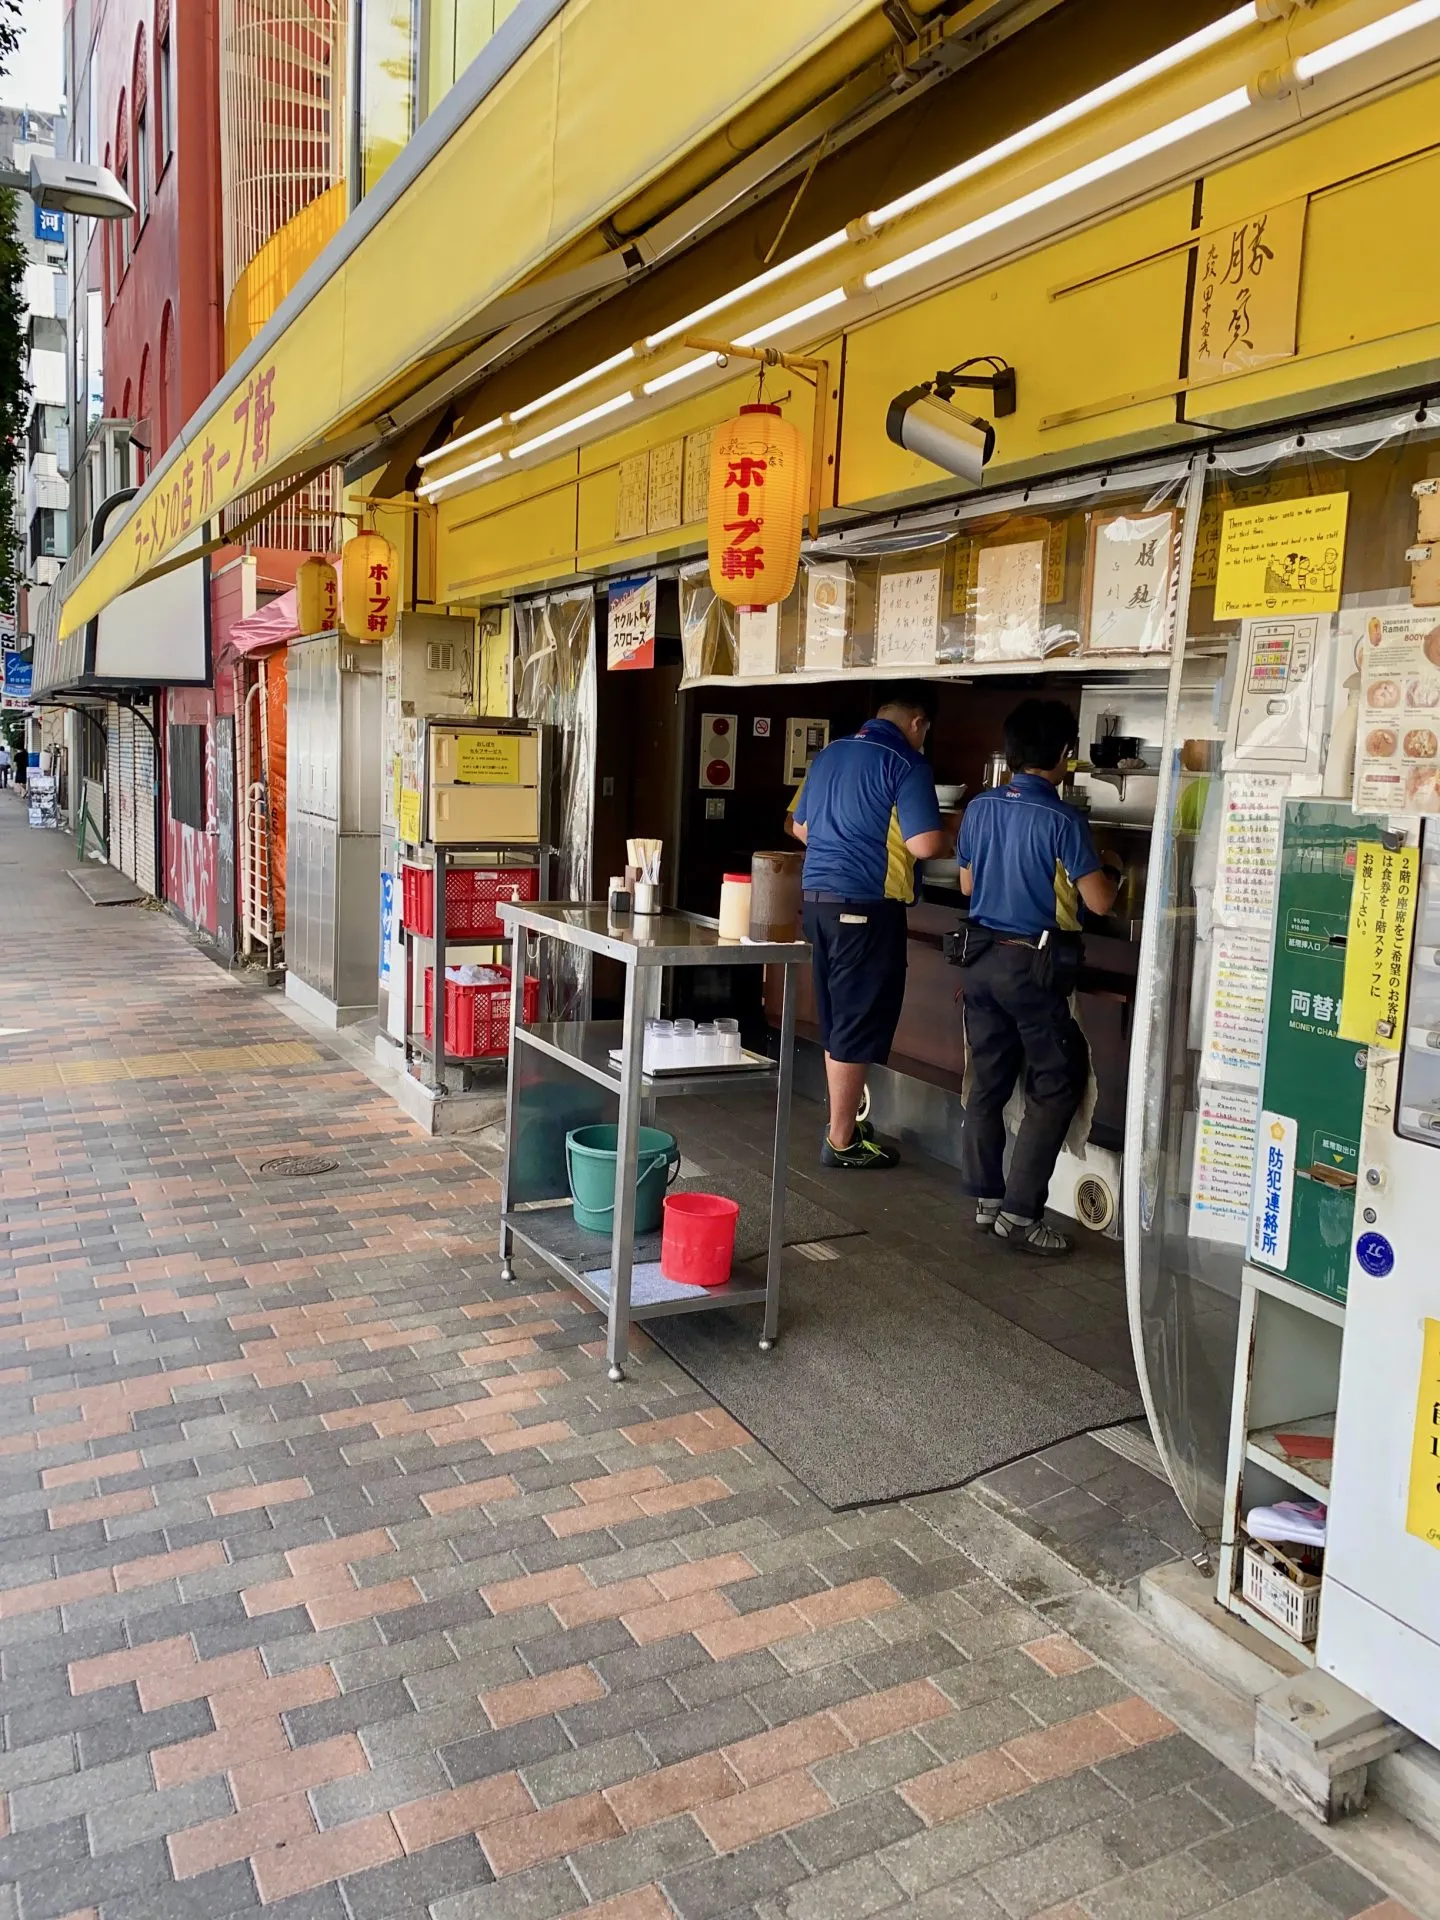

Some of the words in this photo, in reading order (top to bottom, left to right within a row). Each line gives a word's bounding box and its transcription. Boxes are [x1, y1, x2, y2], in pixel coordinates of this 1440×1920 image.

[40, 210, 64, 232] 河
[134, 456, 194, 574] ラーメンの店
[200, 366, 276, 514] ホープ軒
[720, 456, 768, 580] ホープ軒
[1315, 504, 1332, 514] second
[1316, 533, 1324, 541] the
[367, 563, 391, 632] ホープ軒
[613, 610, 640, 628] ヤクルト
[1382, 618, 1411, 626] Japanese
[613, 629, 647, 648] スワローズ
[1382, 624, 1410, 634] Ramen
[1356, 852, 1375, 936] お渡し下さい。
[1370, 854, 1394, 998] は食券を1階スタッフに
[1288, 938, 1321, 951] 紙幣挿入口
[1289, 1020, 1316, 1033] MONEY
[1322, 1138, 1357, 1157] 紙幣取出口
[1261, 1146, 1285, 1257] 防犯連絡所
